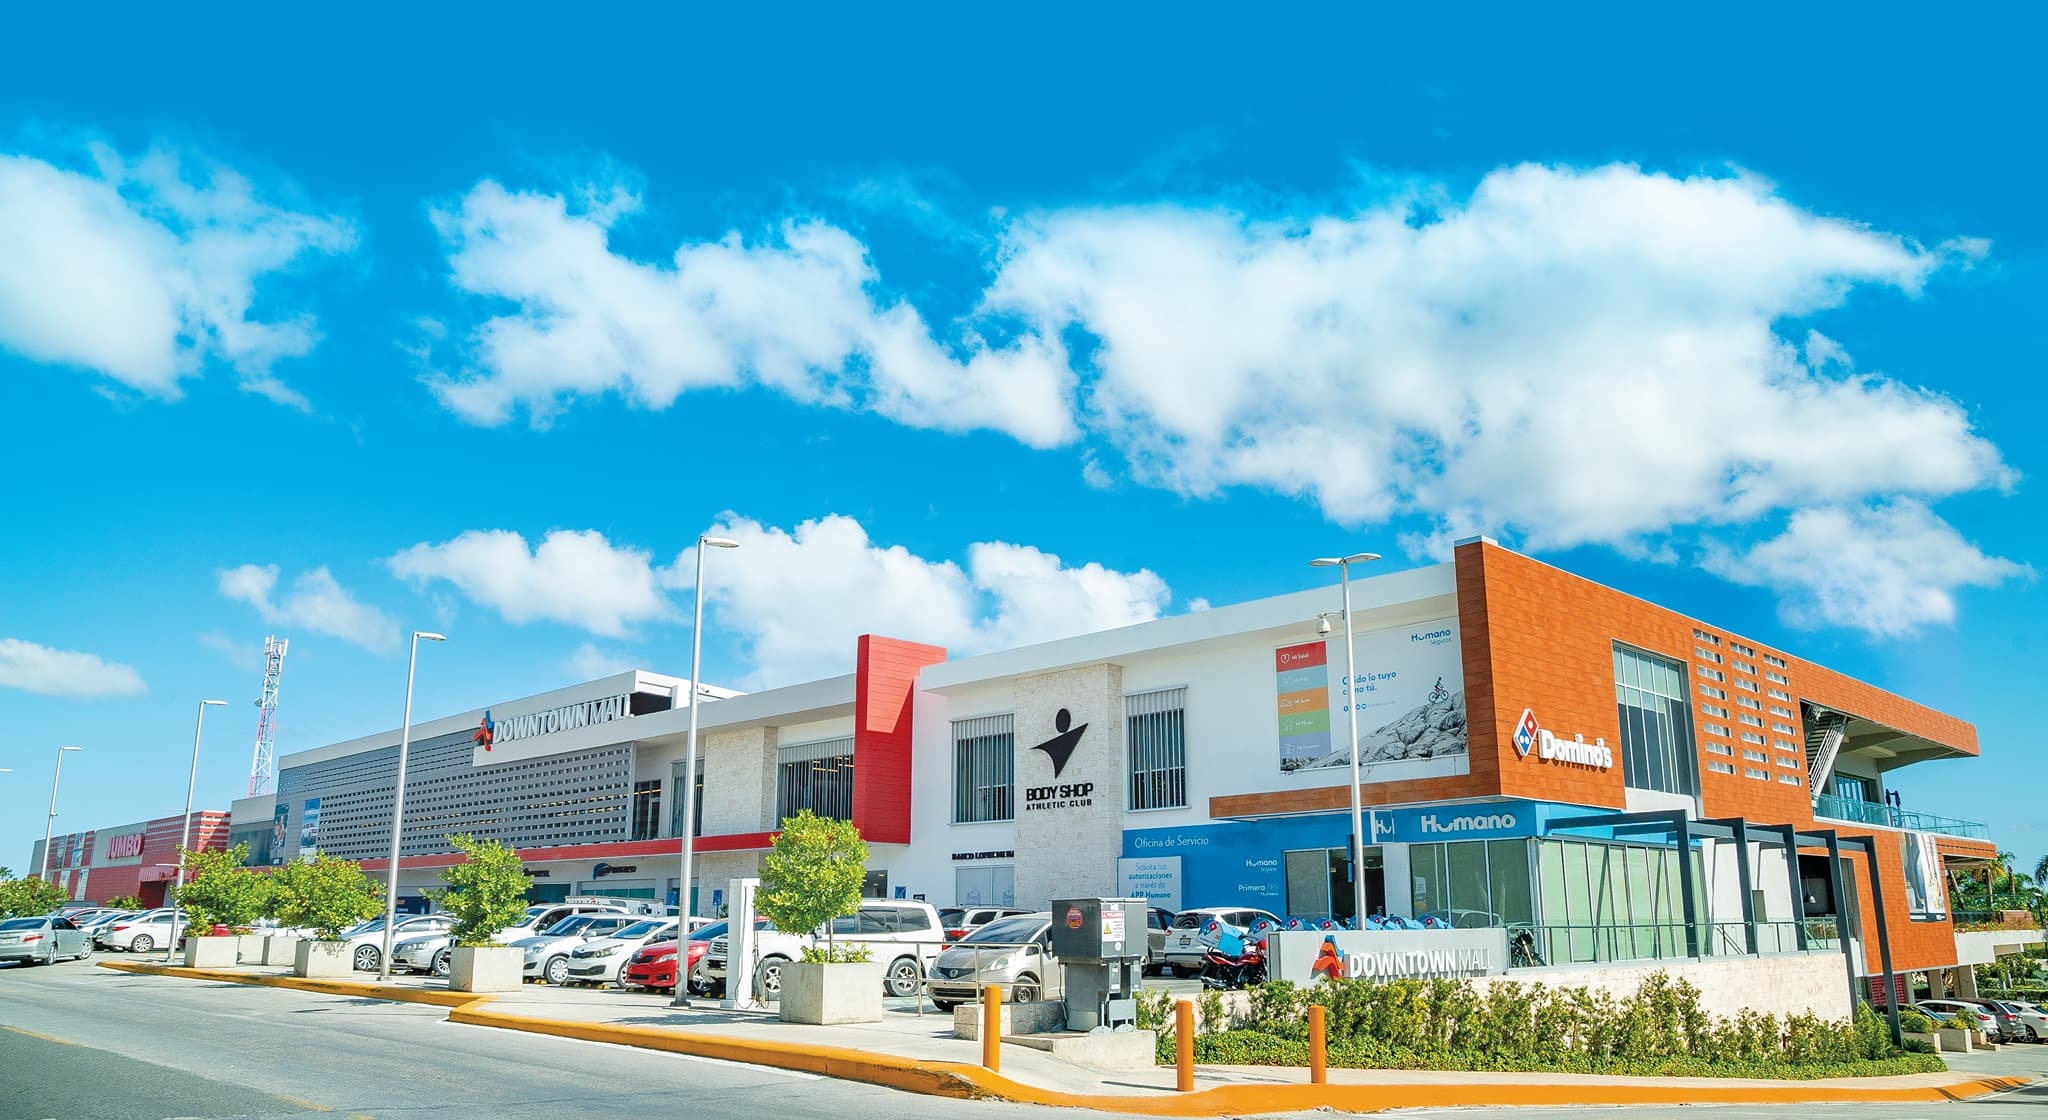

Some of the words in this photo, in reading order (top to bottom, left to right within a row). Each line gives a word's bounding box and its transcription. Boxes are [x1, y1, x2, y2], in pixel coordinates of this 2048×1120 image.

[1411, 629, 1451, 642] Humano
[1368, 673, 1376, 681] lo
[1378, 672, 1396, 680] tuyo
[493, 702, 589, 744] DOWNTOWN
[589, 694, 634, 725] MALL
[1538, 729, 1613, 768] Domino's
[1026, 786, 1058, 801] BODY
[1060, 782, 1094, 798] SHOP
[1026, 801, 1066, 811] ATHLETIC
[1070, 799, 1092, 807] CLUB
[1420, 814, 1516, 833] Humano
[106, 834, 144, 858] JUMBO
[1135, 836, 1163, 848] Oficina
[1164, 837, 1175, 846] de
[1177, 834, 1209, 846] Servicio
[1128, 872, 1172, 880] autorizaciones
[1351, 950, 1456, 978] DOWNTOWN
[1458, 949, 1495, 971] MALL
